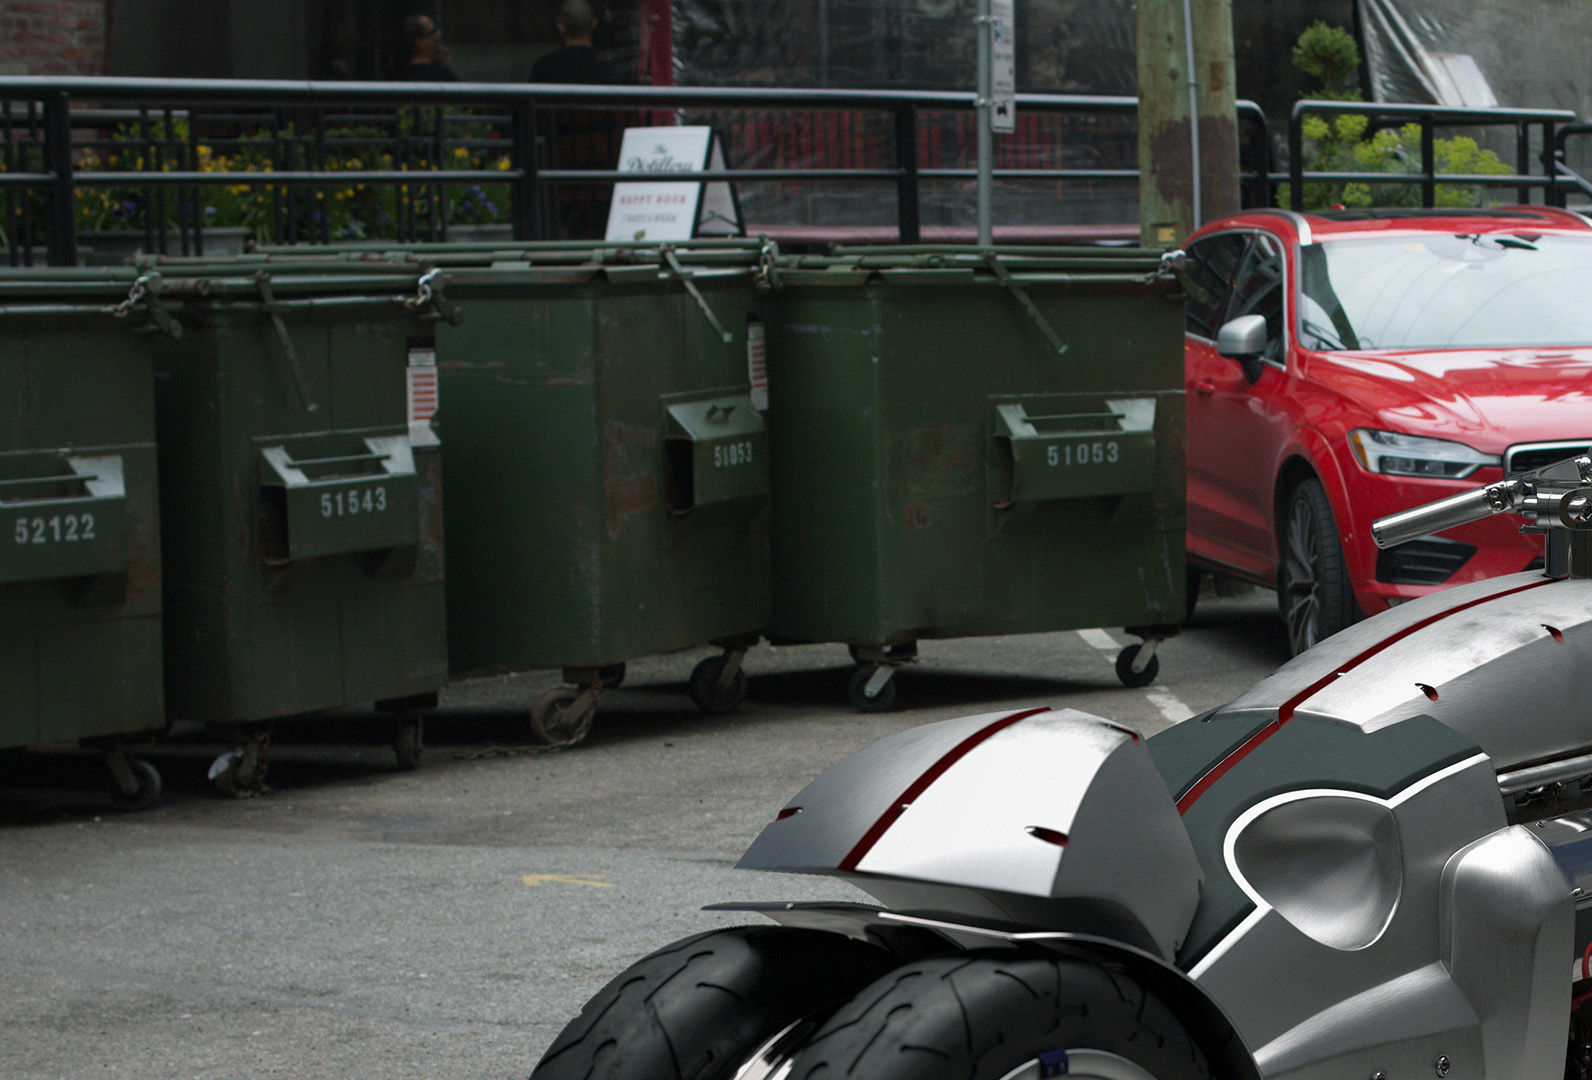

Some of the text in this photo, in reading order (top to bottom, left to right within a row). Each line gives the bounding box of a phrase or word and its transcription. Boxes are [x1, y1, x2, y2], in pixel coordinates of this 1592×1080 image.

[713, 441, 754, 468] 51053
[1047, 442, 1120, 467] 51053
[319, 487, 388, 518] 51543
[14, 513, 96, 544] 52122
